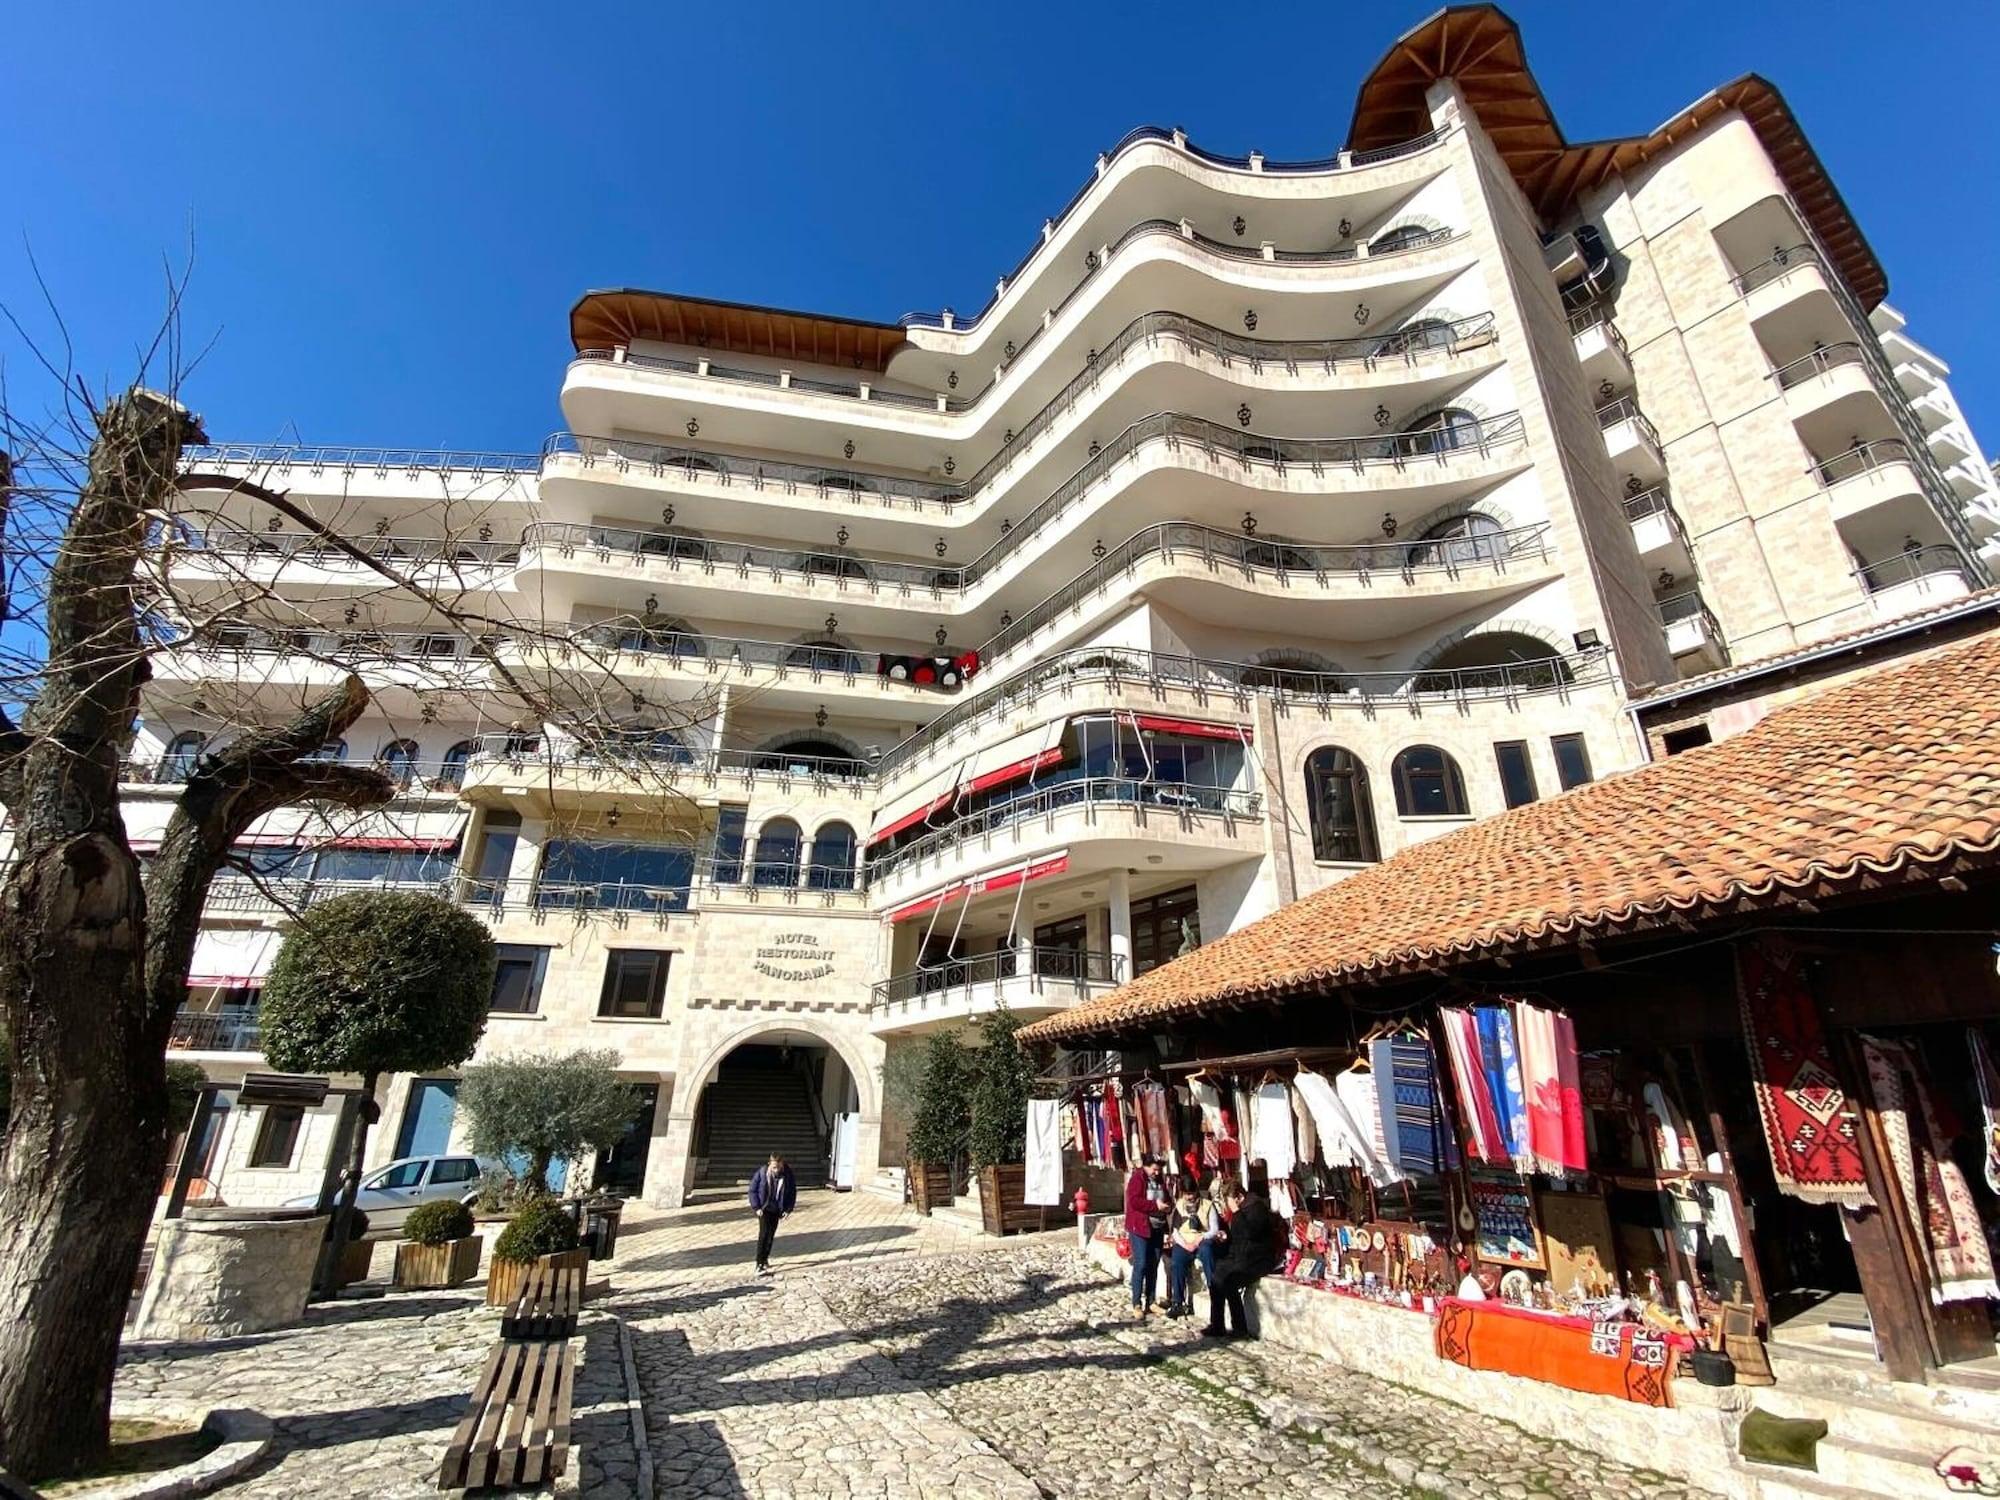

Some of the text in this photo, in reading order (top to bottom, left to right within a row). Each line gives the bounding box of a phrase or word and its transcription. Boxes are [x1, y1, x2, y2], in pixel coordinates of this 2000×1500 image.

[774, 933, 819, 946] HOTEL
[756, 948, 836, 961] RESTORANT
[753, 961, 836, 982] PANORAMA
